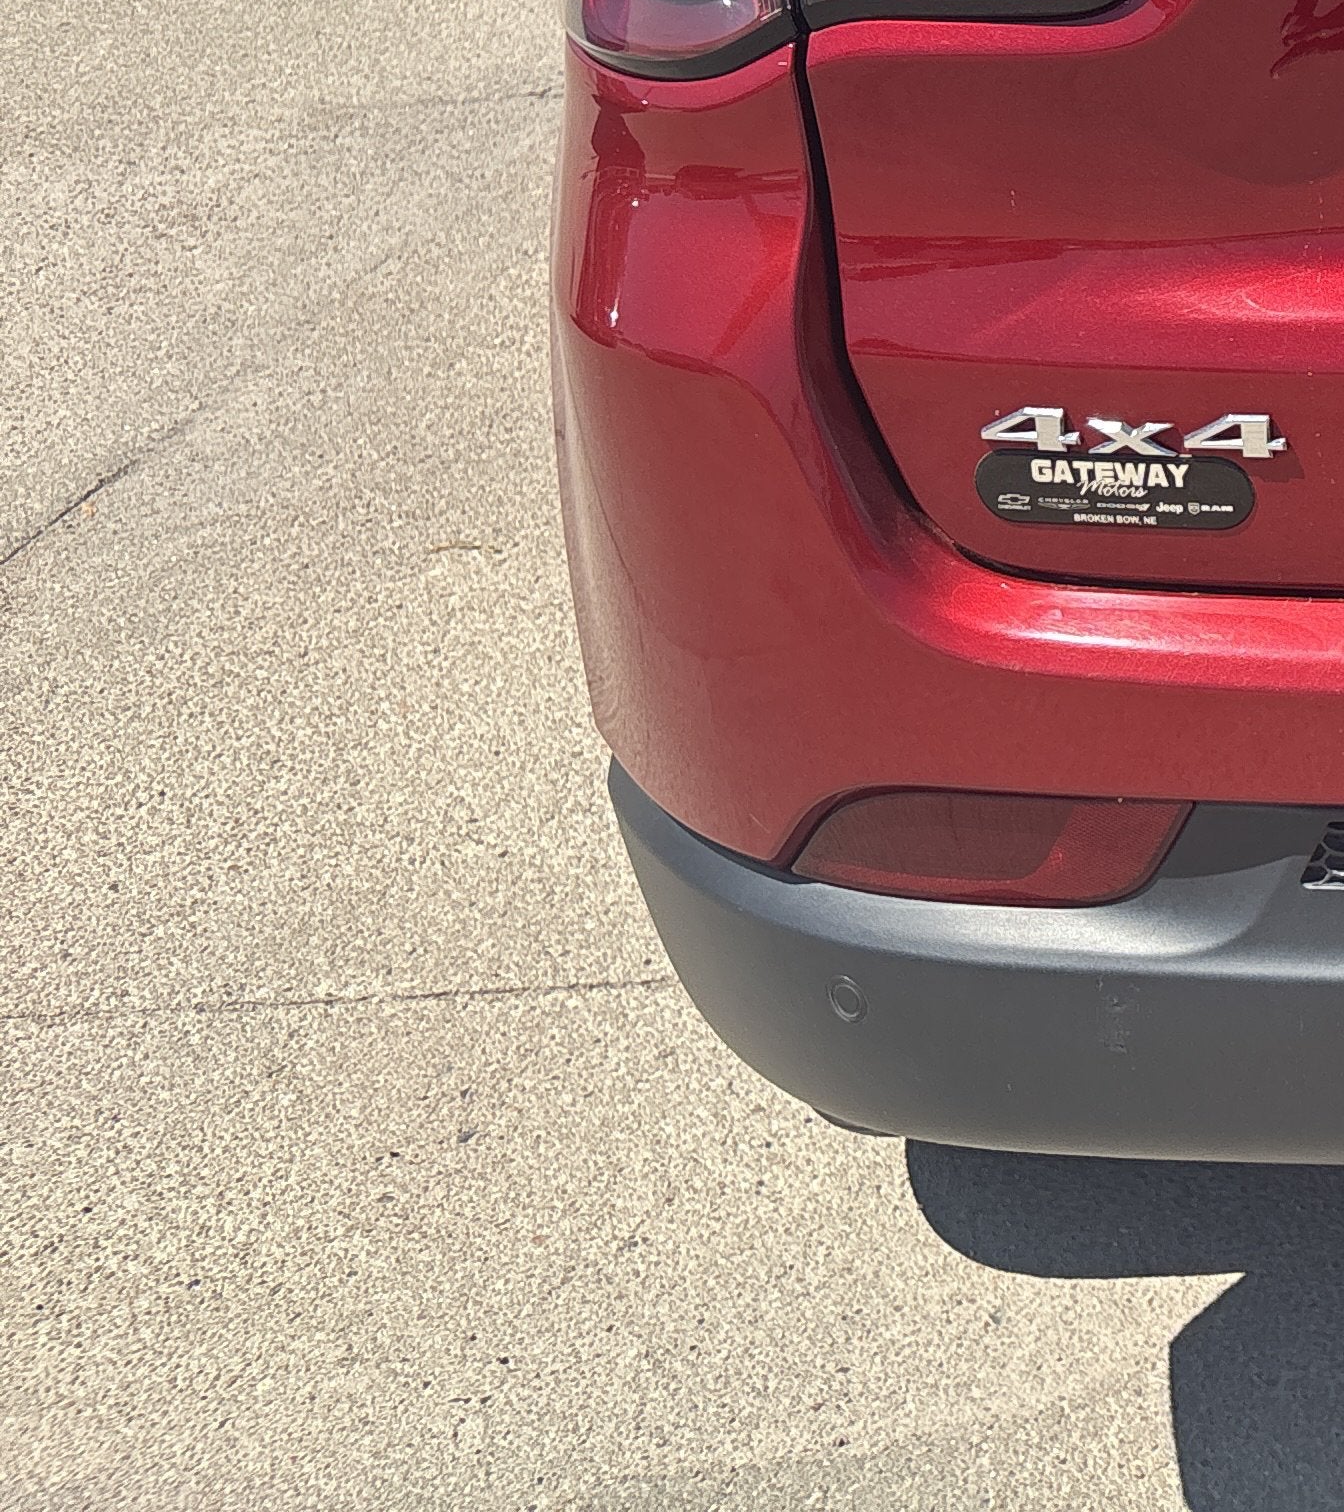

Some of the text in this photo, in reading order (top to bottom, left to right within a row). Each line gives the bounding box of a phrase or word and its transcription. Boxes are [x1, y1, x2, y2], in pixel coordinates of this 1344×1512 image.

[1030, 458, 1190, 488] GATEWAY
[1075, 479, 1149, 498] Motors
[1155, 501, 1184, 515] Jeep
[1073, 513, 1115, 524] BROKEN
[1143, 515, 1158, 525] NE
